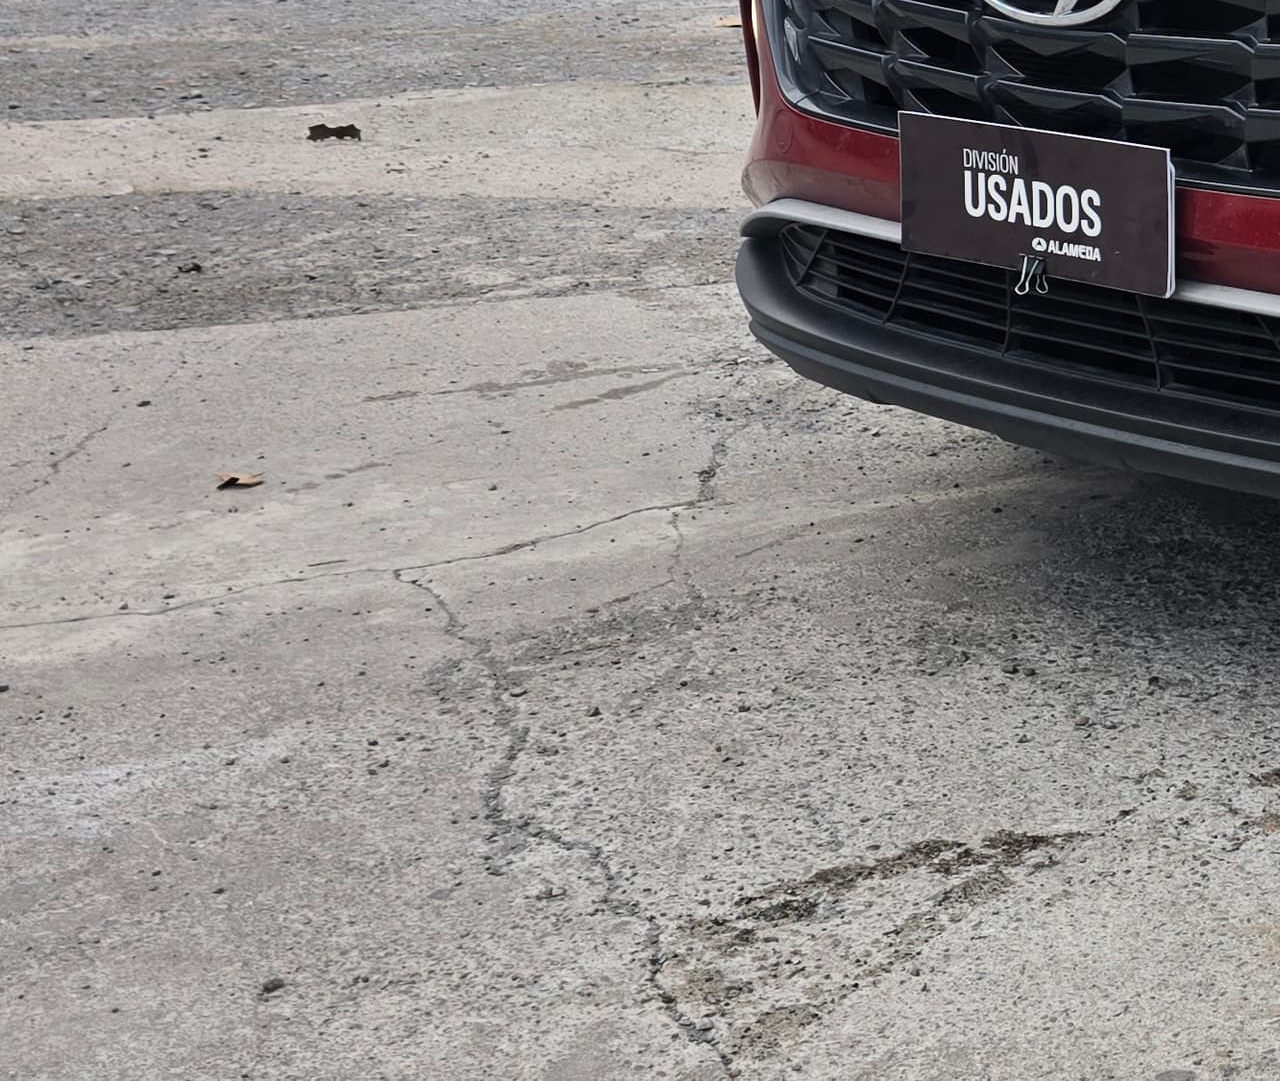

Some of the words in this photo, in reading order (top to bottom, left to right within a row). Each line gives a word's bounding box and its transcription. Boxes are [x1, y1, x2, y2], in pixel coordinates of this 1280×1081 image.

[963, 148, 1019, 175] DIVISIÓN
[964, 170, 1102, 237] USADOS
[1047, 239, 1102, 262] ALAMEDA
